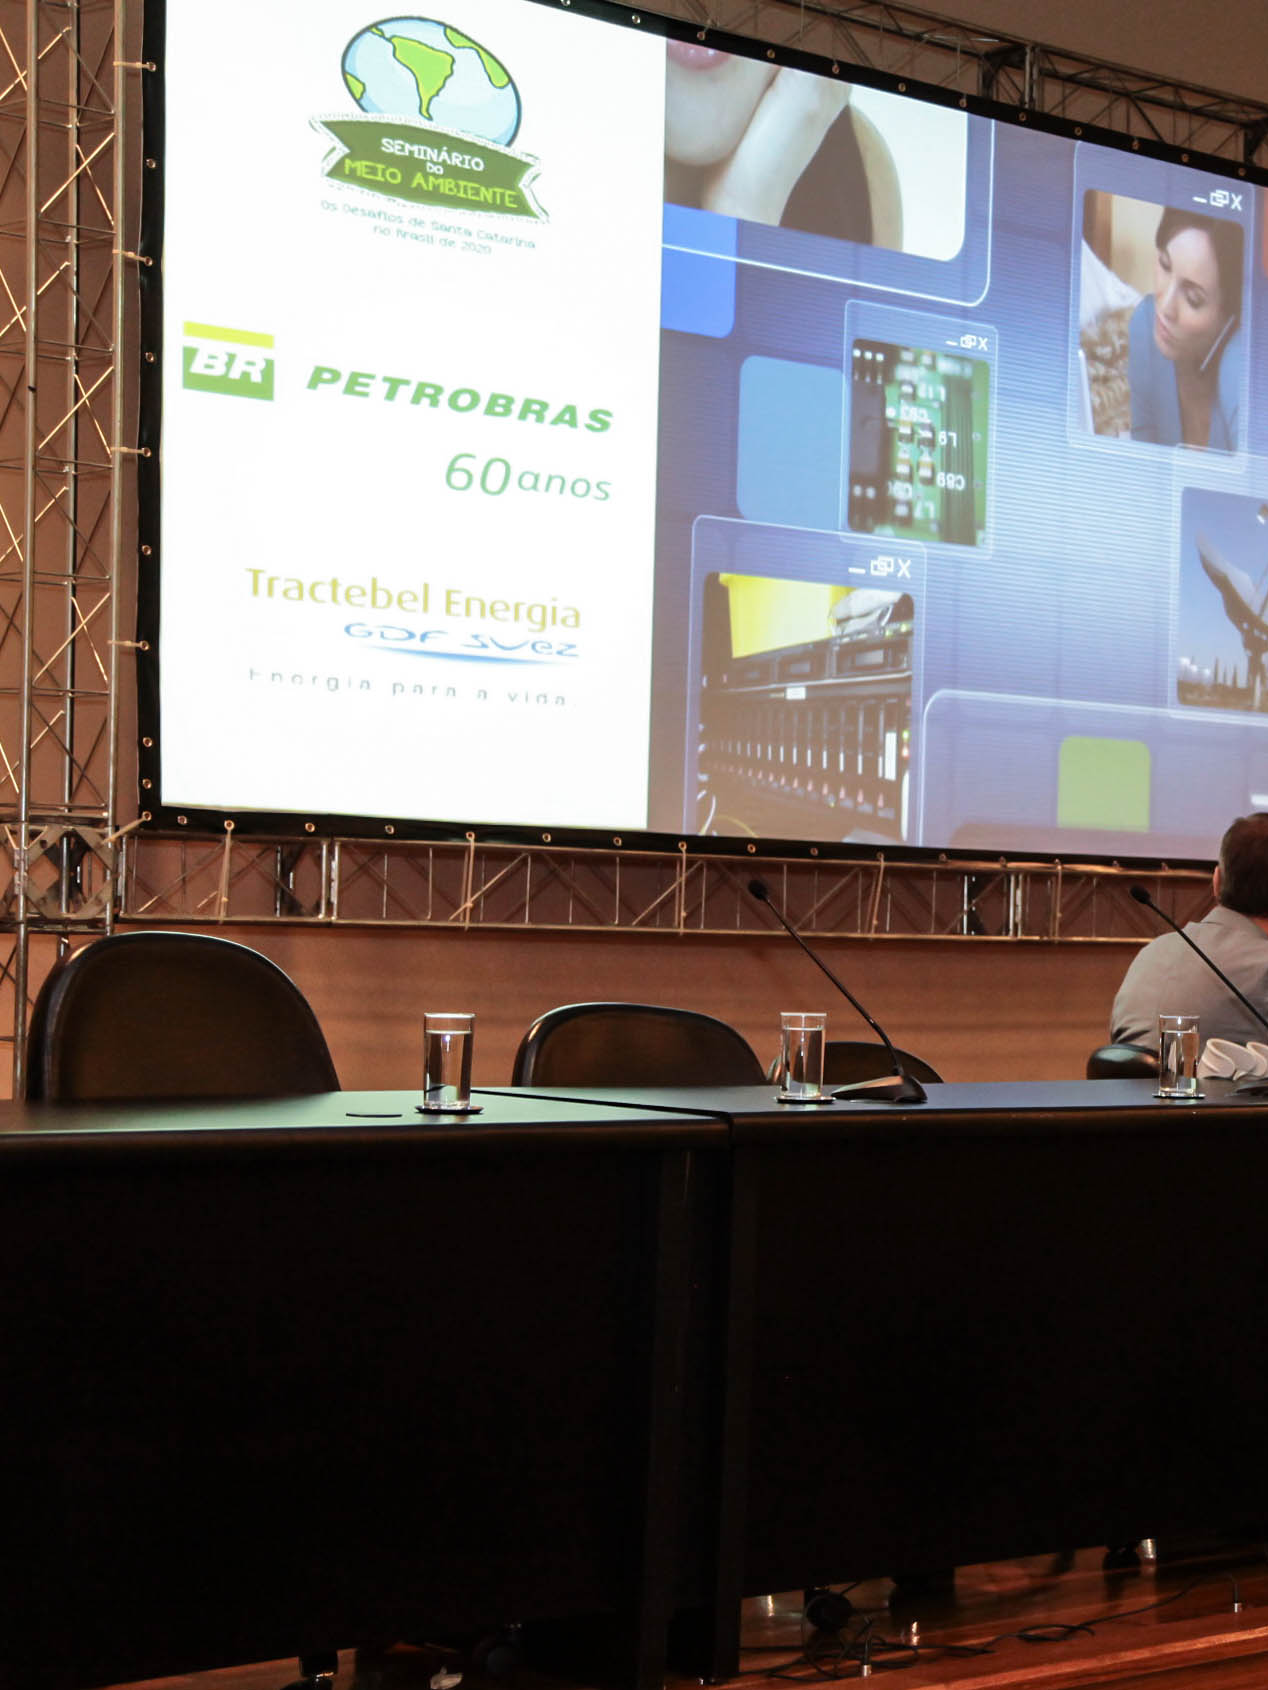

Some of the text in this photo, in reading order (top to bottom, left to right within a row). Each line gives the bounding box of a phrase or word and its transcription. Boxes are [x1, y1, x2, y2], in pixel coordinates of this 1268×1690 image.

[380, 137, 485, 172] SEMINÁRIO
[426, 162, 444, 175] DO
[344, 158, 519, 209] MEIO AMBIENTE
[408, 215, 426, 229] de
[431, 219, 473, 238] Santa
[477, 227, 537, 250] Catarina
[439, 233, 456, 248] de
[189, 347, 268, 383] BR
[305, 365, 614, 433] PETROBRAS
[245, 567, 581, 634] Tractebel Energia
[344, 622, 448, 644] GDF
